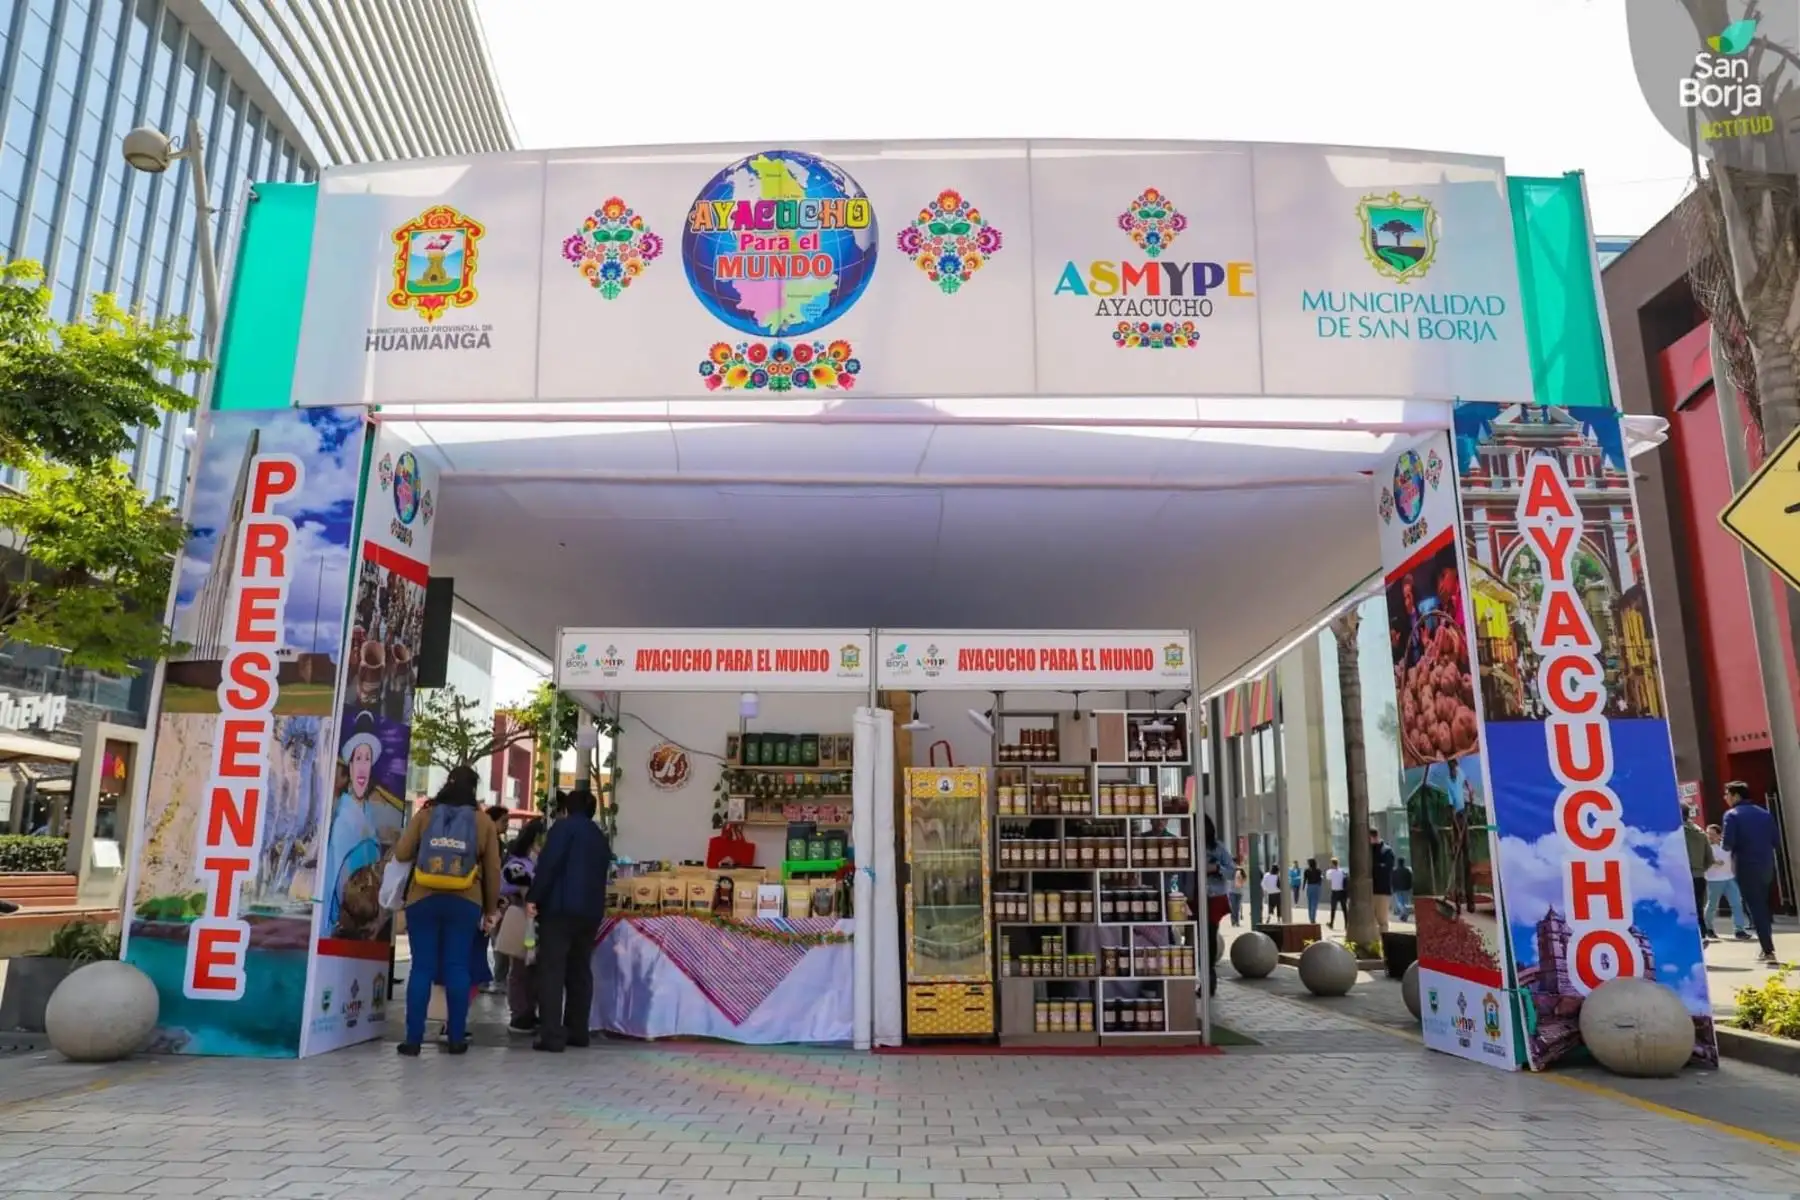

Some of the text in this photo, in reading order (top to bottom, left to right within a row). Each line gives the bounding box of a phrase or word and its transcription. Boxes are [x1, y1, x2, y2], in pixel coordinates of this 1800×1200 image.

[689, 197, 872, 232] AYACUCHO
[740, 233, 819, 251] Para el
[717, 254, 833, 279] MUNDO
[1054, 260, 1255, 297] ASMYPE
[1095, 299, 1213, 317] AYACUCHO
[1302, 289, 1506, 316] MUNICIPALIDAD
[365, 332, 492, 352] HUAMANGA
[1318, 316, 1498, 344] DE SAN BORJA
[635, 648, 830, 672] AYACUCHO PARA EL MUNDO
[958, 647, 1154, 671] AYACUCHO PARA EL MUNDO
[192, 460, 297, 990] PRESENTE
[1524, 464, 1634, 989] AYACUCHO
